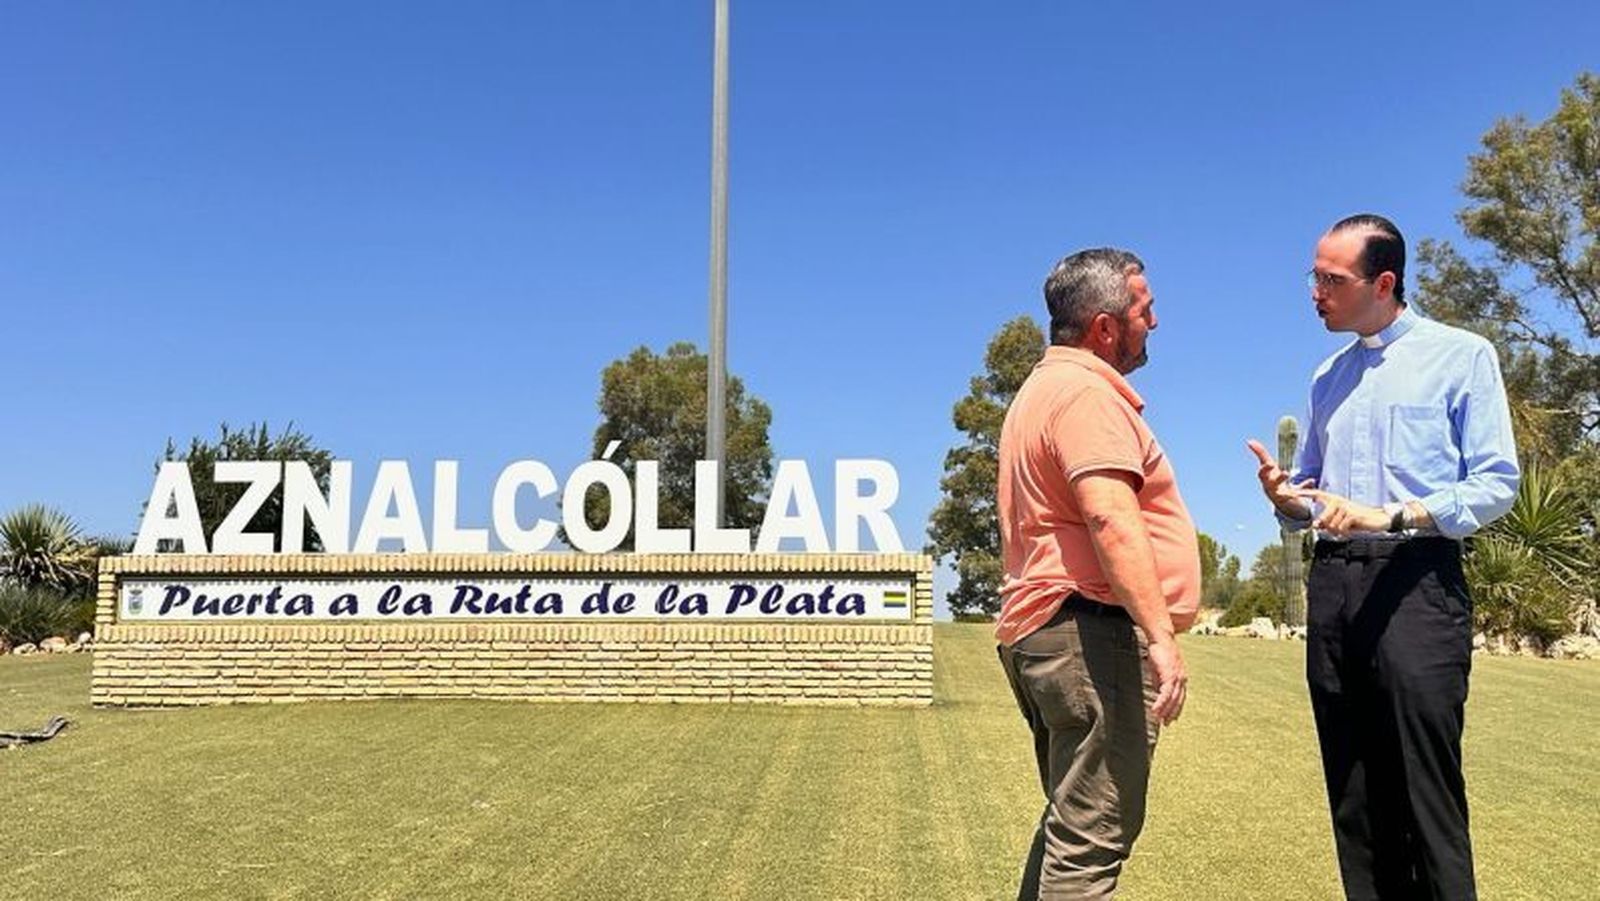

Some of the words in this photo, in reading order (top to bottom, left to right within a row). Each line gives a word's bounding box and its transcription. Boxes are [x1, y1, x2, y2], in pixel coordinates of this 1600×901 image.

[132, 441, 902, 555] AZNALCÓLLAR
[158, 585, 314, 616] Puerta
[328, 593, 358, 615] a
[376, 585, 433, 616] la
[449, 585, 563, 616] Ruta
[580, 584, 636, 615] de
[655, 584, 709, 615] la
[725, 584, 866, 615] Plata
